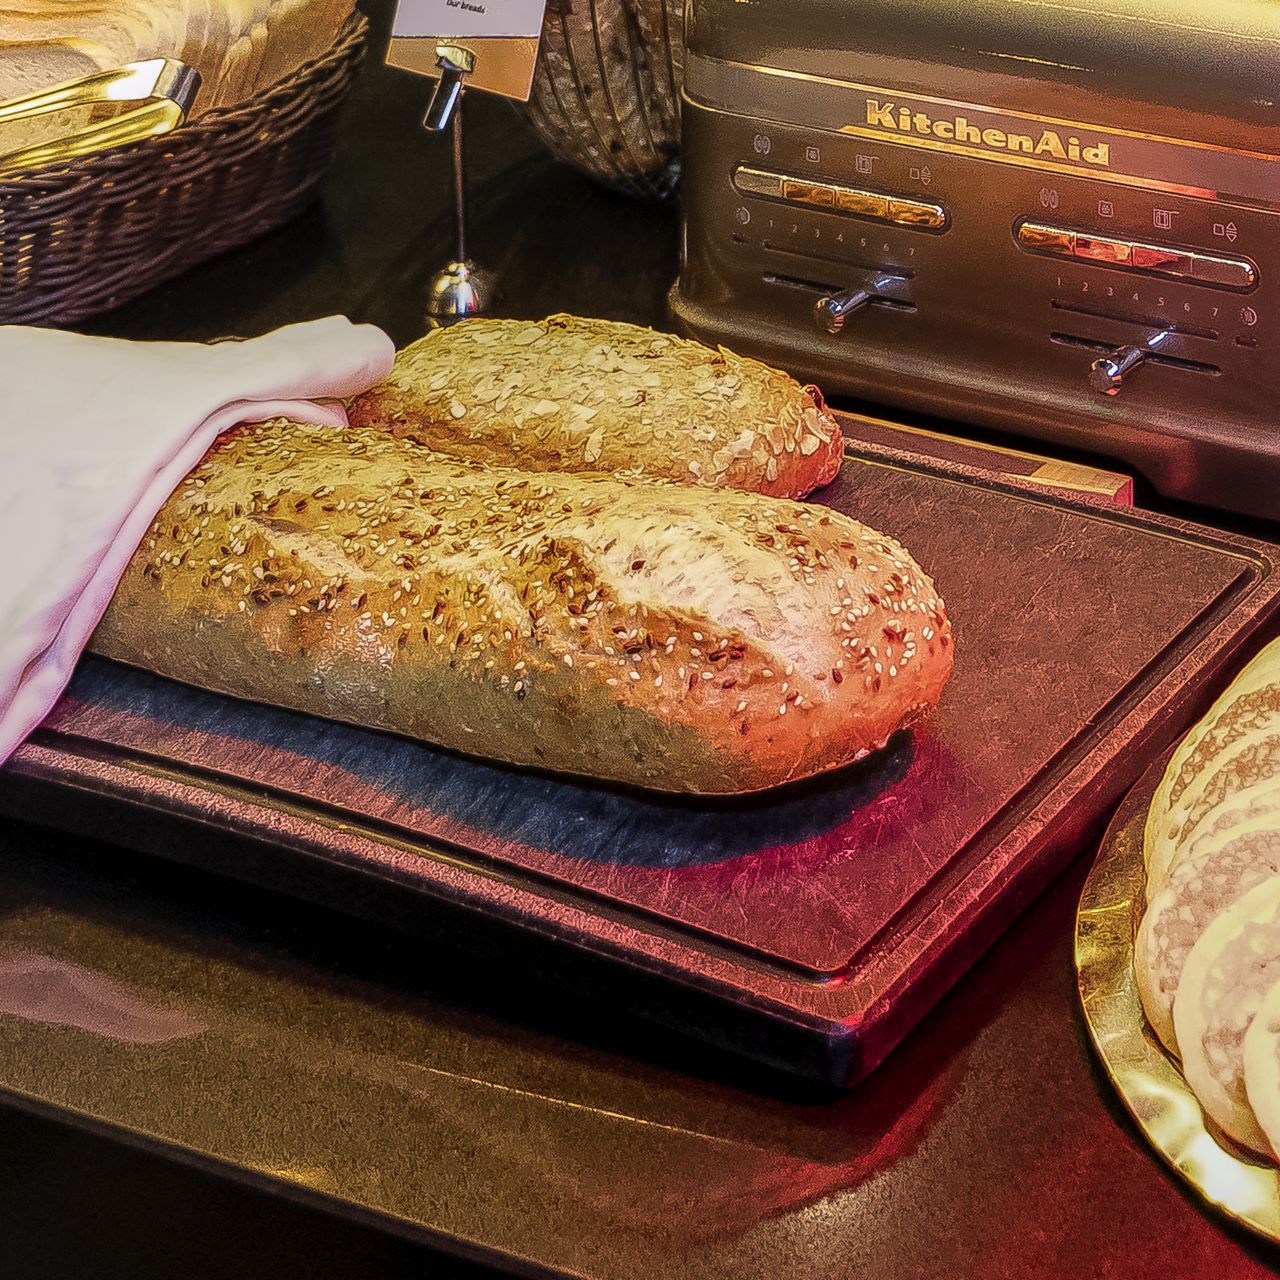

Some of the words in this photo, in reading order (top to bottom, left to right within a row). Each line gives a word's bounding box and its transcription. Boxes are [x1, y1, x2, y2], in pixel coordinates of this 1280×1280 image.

[866, 99, 1111, 166] KitchenAid
[769, 219, 773, 228] 1
[792, 224, 798, 233] 2
[815, 229, 821, 238] 3
[836, 233, 843, 242] 4
[860, 238, 866, 247] 5
[883, 243, 890, 252] 6
[909, 248, 915, 256] 7
[1057, 277, 1061, 286] 1
[1082, 282, 1089, 292] 2
[1107, 287, 1114, 296] 3
[1133, 292, 1139, 301] 4
[1157, 297, 1165, 306] 5
[1183, 302, 1190, 312] 6
[1212, 307, 1219, 317] 7
